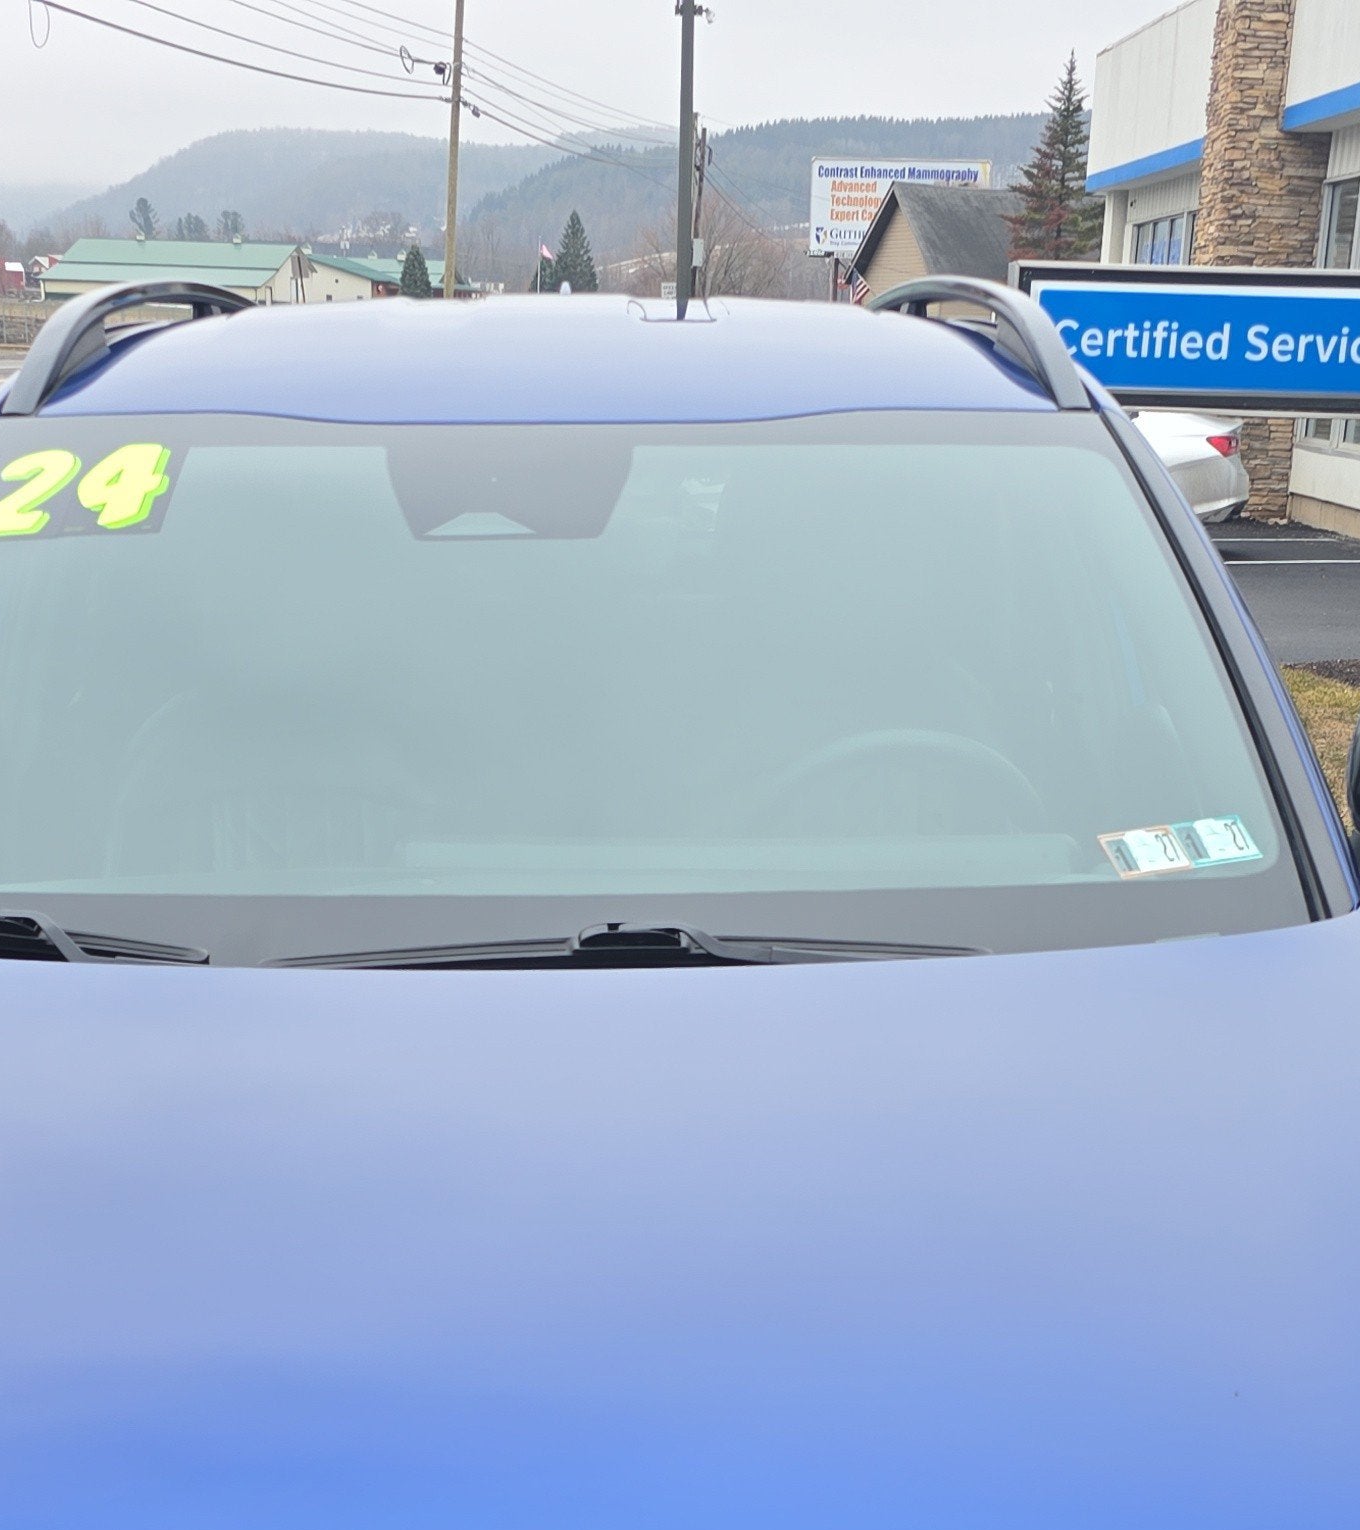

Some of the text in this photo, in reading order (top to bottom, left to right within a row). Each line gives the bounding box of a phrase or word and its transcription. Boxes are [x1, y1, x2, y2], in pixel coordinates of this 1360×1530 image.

[818, 165, 979, 183] Contrast Enhanced Mammography
[830, 180, 878, 194] Advanced
[830, 208, 876, 222] Expert Ca
[1053, 317, 1232, 361] Certified
